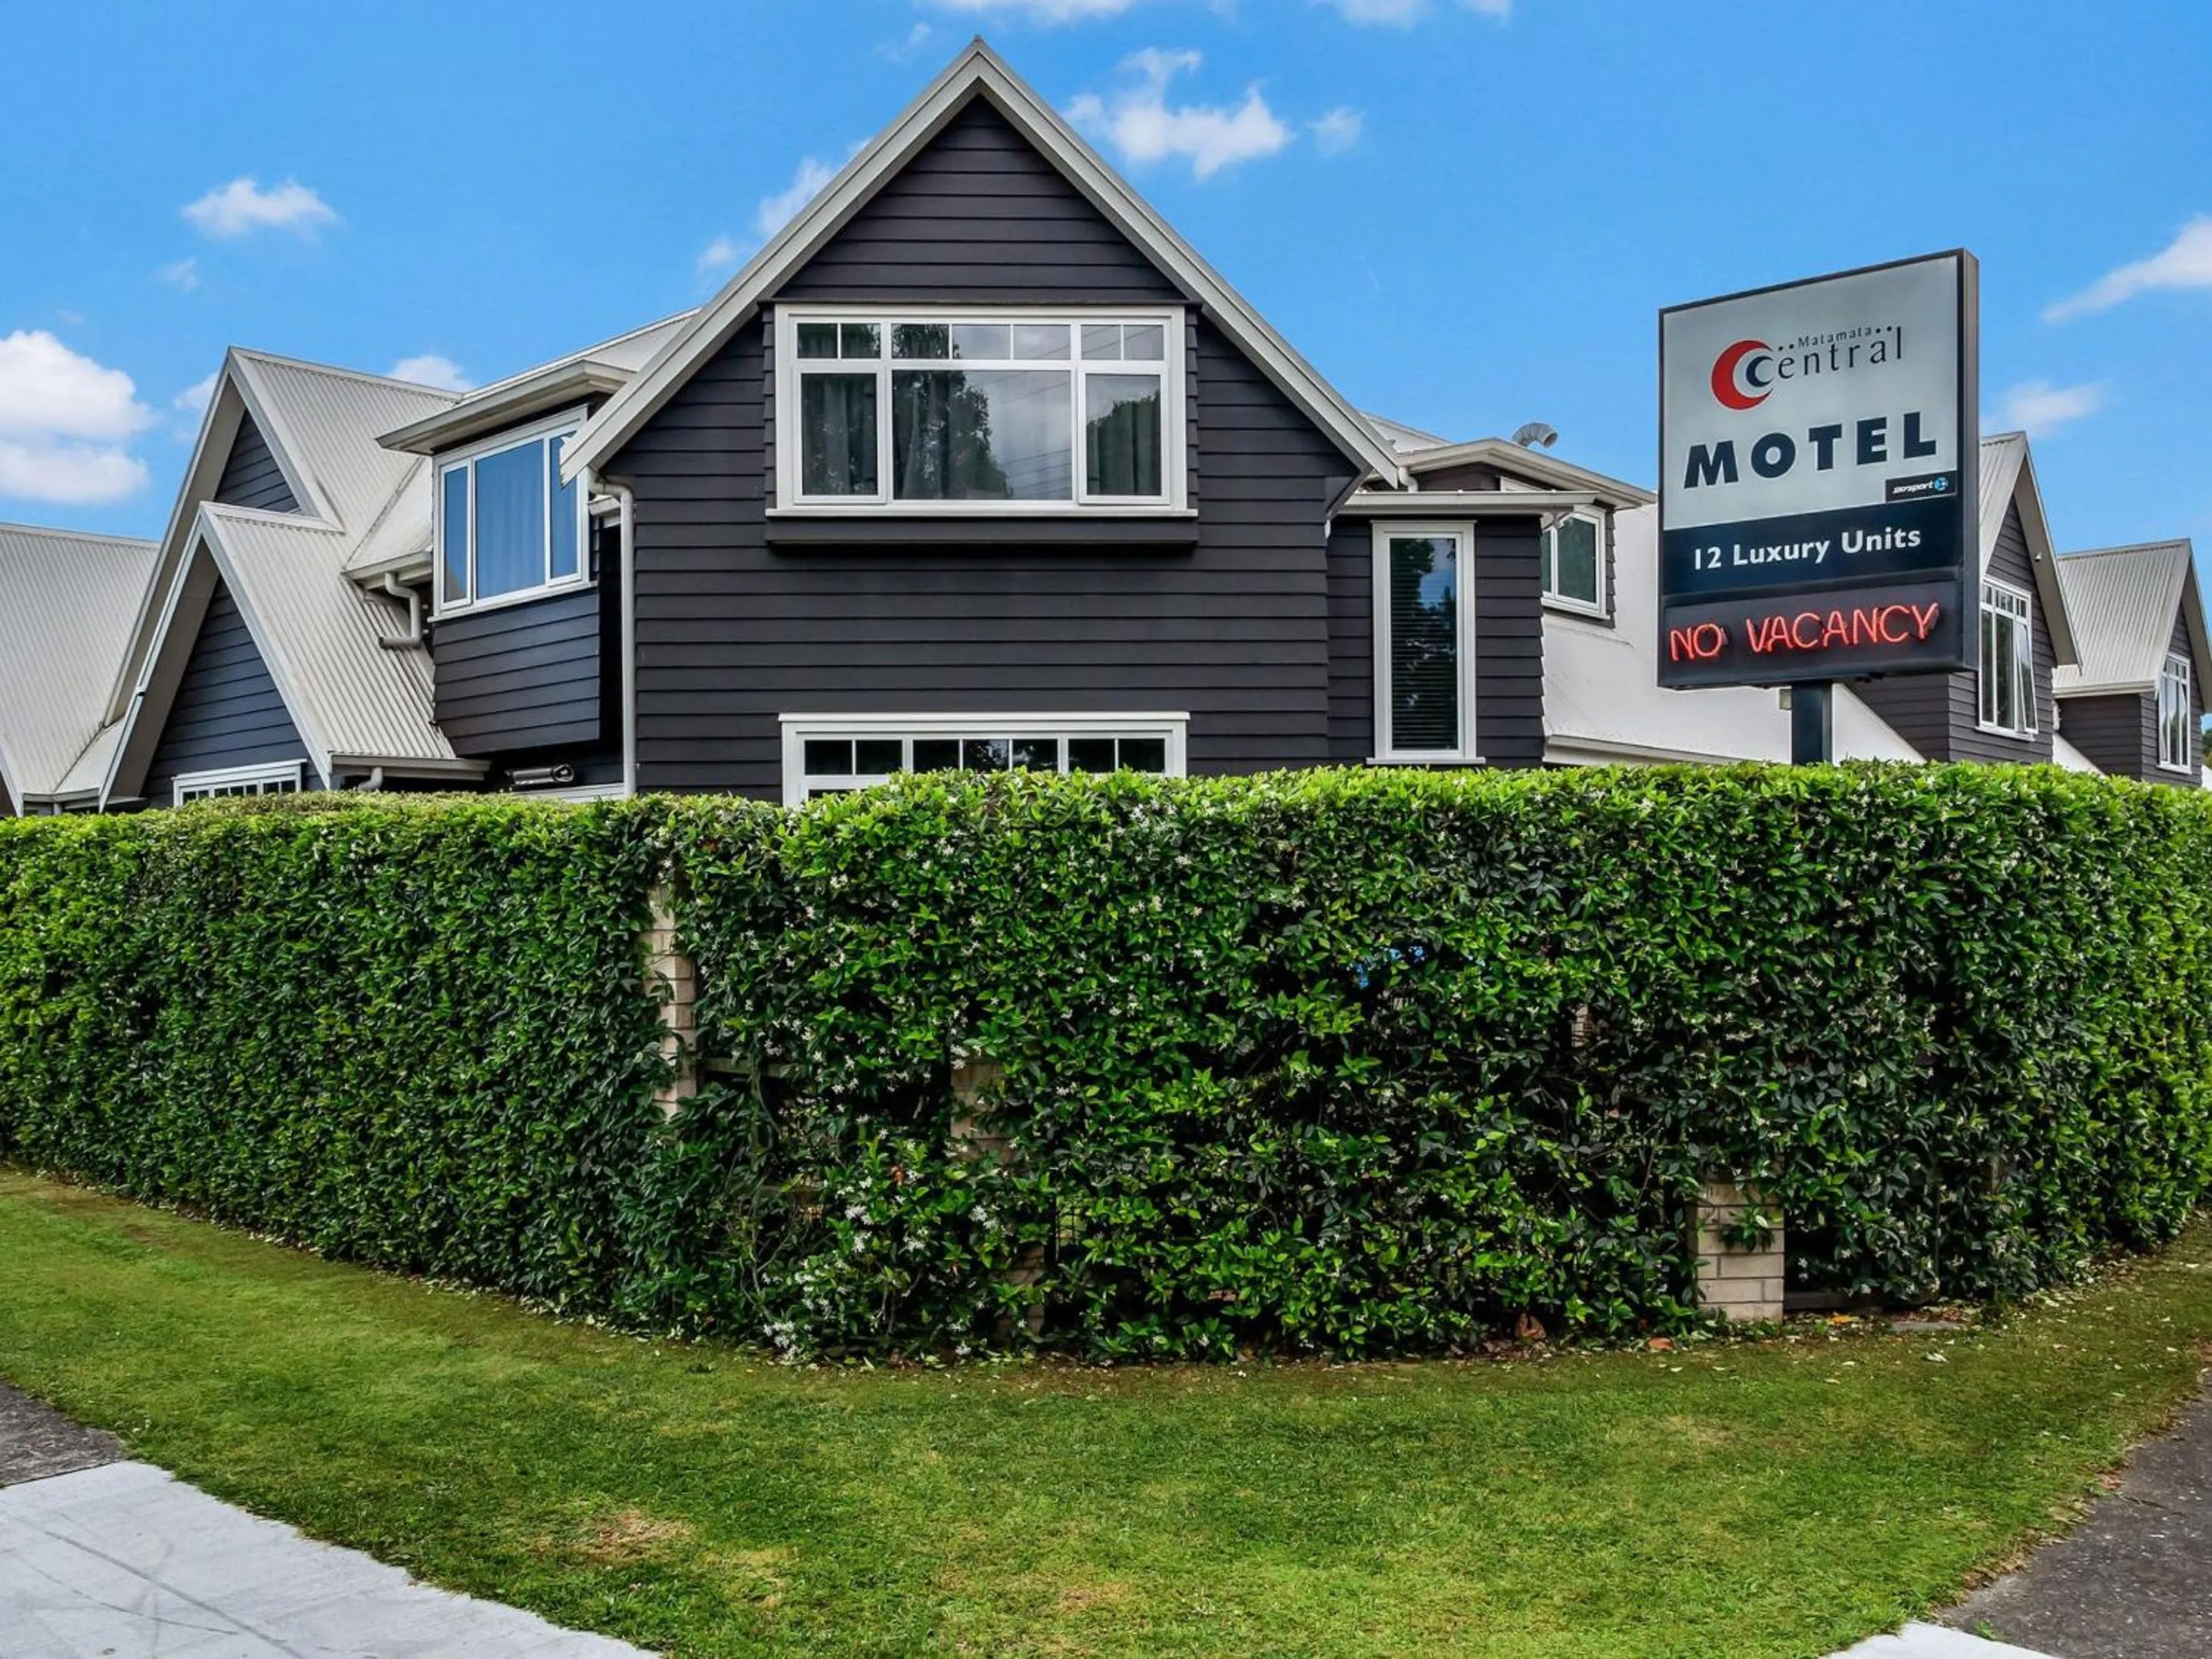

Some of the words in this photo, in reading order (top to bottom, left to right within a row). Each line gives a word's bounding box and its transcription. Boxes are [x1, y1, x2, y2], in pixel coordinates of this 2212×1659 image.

[1745, 326, 1902, 387] Central
[1798, 326, 1873, 348] Matamata
[1684, 412, 1937, 489] MOTEL
[1694, 546, 1722, 571] 12
[1733, 540, 1831, 566] Luxury
[1841, 527, 1921, 554] Units
[1670, 623, 1724, 661] NO
[1745, 602, 1939, 653] VACANCY
